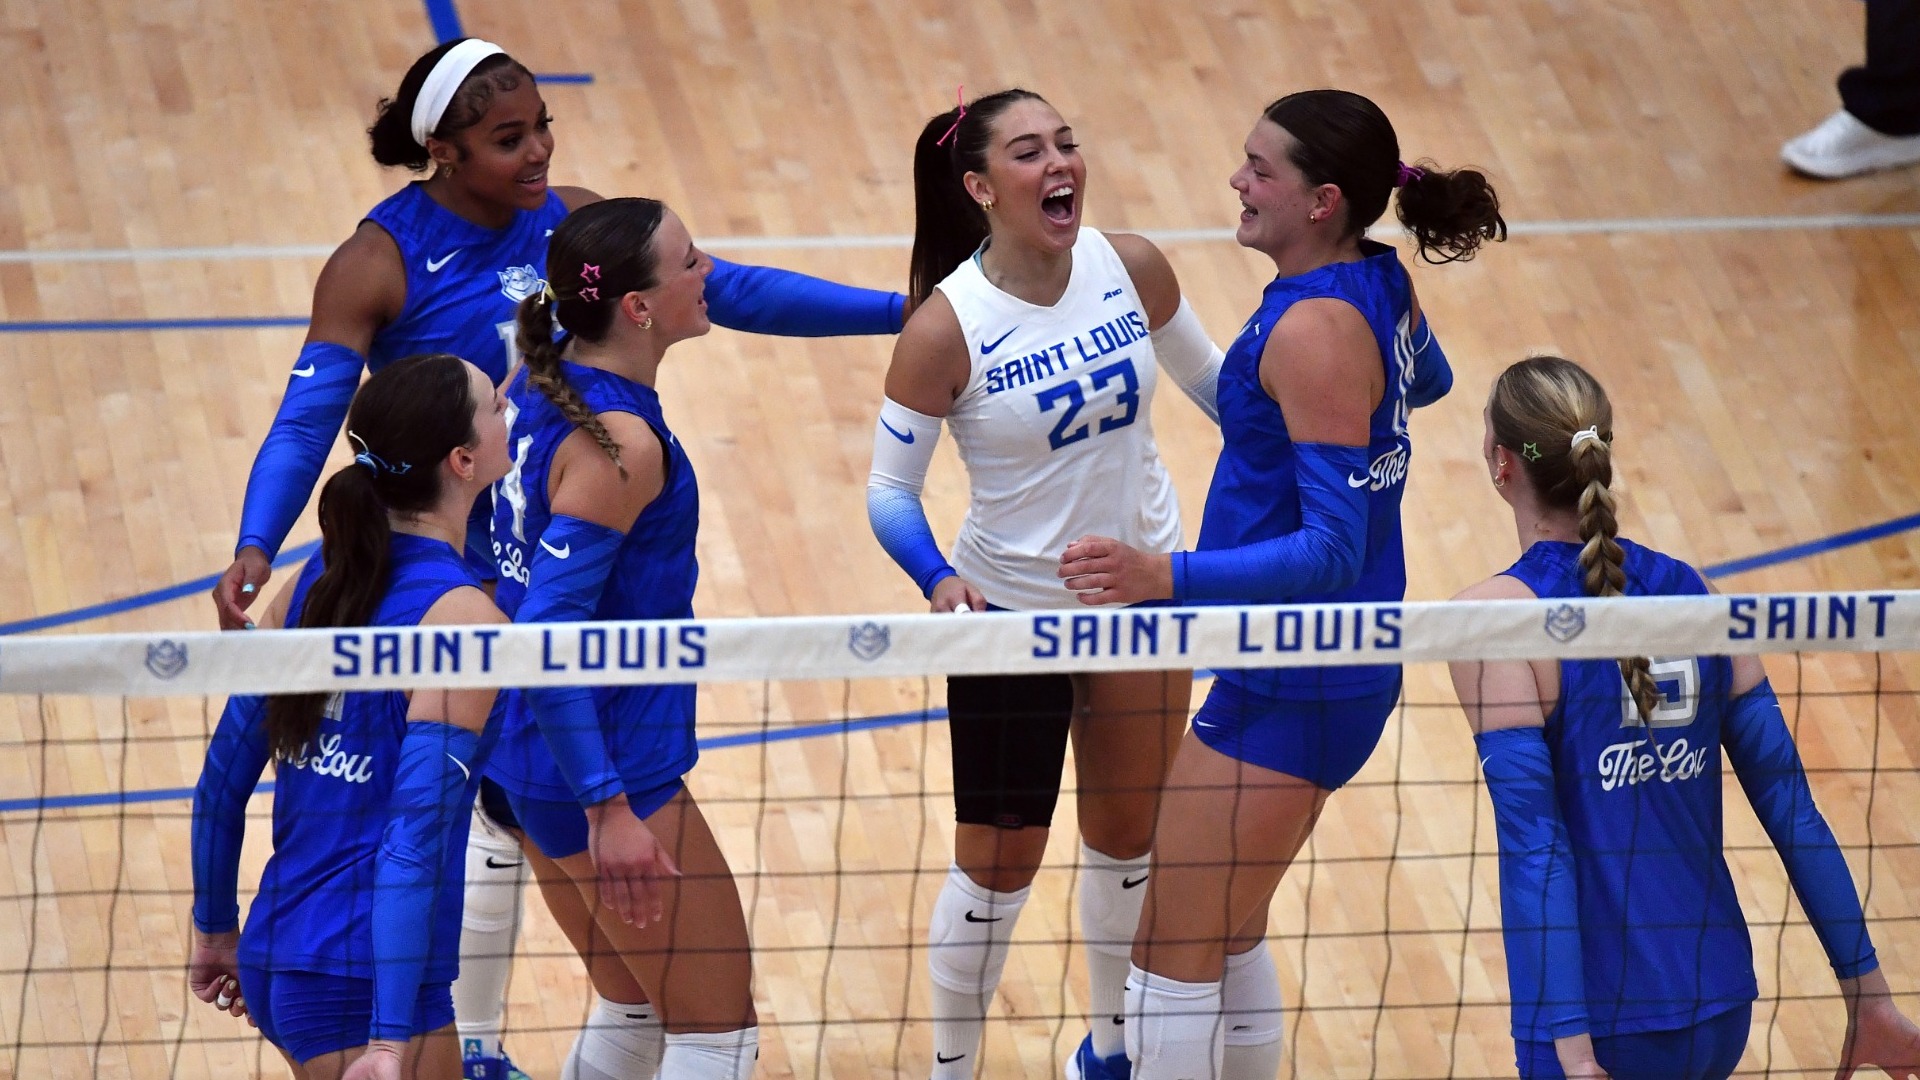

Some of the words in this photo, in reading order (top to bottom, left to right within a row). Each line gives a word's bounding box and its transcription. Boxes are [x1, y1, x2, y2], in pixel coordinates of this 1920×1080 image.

[986, 342, 1068, 394] SAINT
[1073, 310, 1148, 362] LOUIS
[1032, 357, 1140, 451] 23
[1369, 441, 1407, 491] The
[1032, 612, 1199, 659] SAINT
[1238, 608, 1403, 653] LOUIS
[1727, 594, 1896, 640] SAINT
[332, 630, 501, 677] SAINT
[542, 626, 707, 672] LOUIS
[310, 733, 373, 784] Lou
[1599, 739, 1656, 792] The
[1655, 738, 1707, 783] Lou
